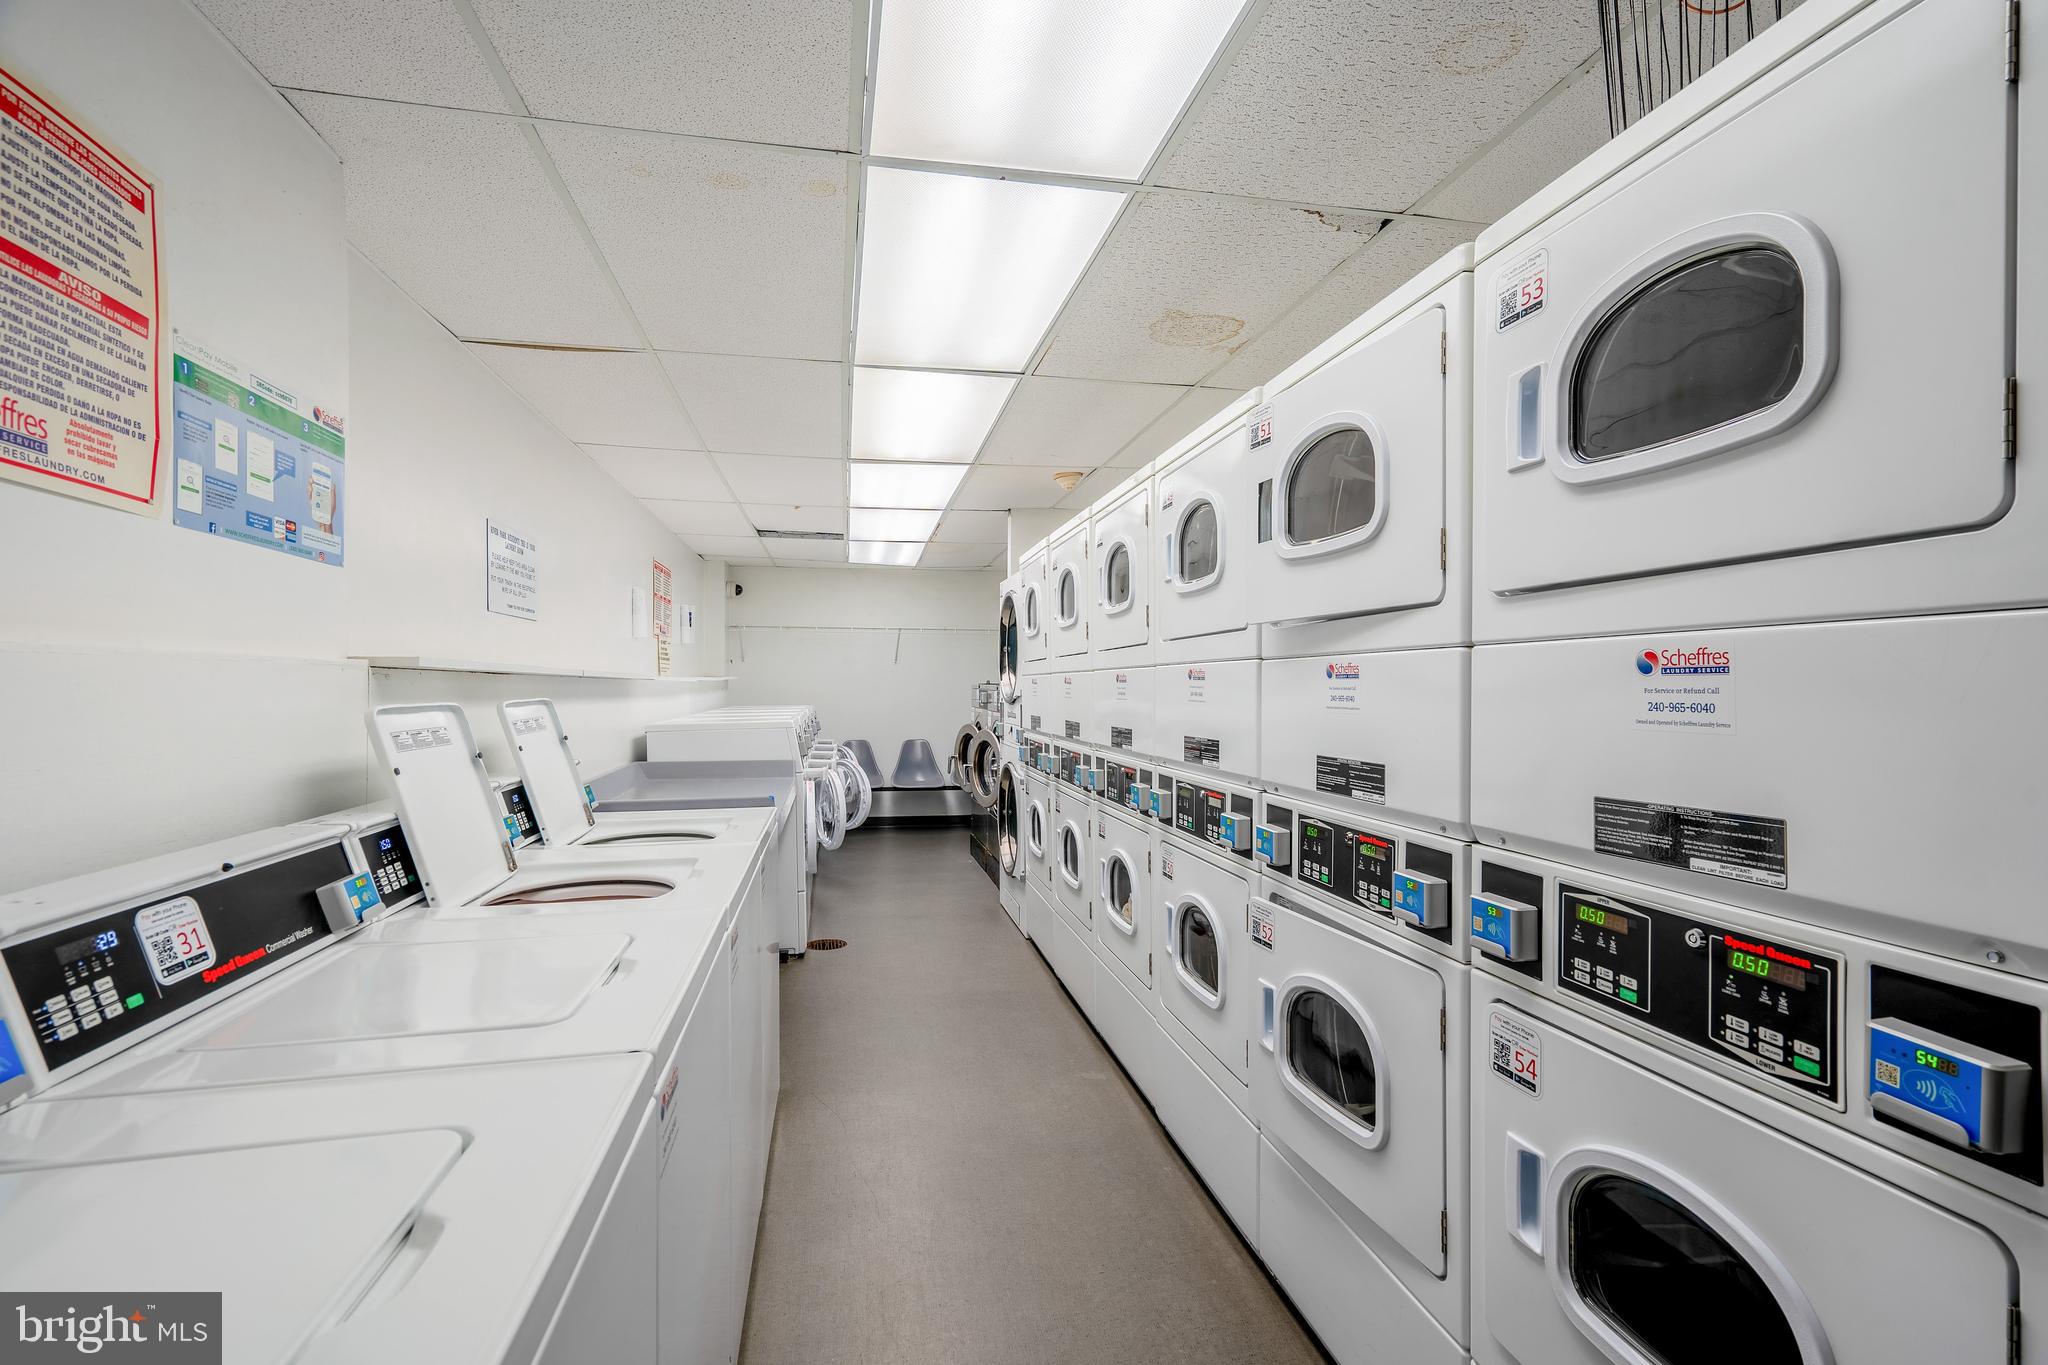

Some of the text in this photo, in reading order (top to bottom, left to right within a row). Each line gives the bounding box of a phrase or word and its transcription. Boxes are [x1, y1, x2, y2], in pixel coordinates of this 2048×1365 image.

[31, 153, 39, 165] LA
[42, 160, 85, 197] TEMPERATURA
[88, 193, 94, 203] DE
[1, 192, 15, 207] POR
[45, 219, 61, 235] DEJE
[63, 230, 74, 243] LAS
[8, 224, 16, 235] EL
[40, 242, 49, 254] DE
[51, 249, 59, 260] LA
[58, 271, 101, 303] AVISO
[1521, 277, 1543, 306] 53
[12, 274, 42, 296] MAYORIA
[45, 292, 54, 302] DE
[56, 298, 64, 307] LA
[66, 303, 82, 317] ROPA
[84, 312, 106, 329] ACTUAL
[108, 324, 121, 337] ESTA
[61, 312, 68, 322] DE
[71, 318, 101, 338] MATERIAL
[136, 351, 143, 359] SE
[3, 334, 135, 397] SECADA EN EXCESO EN UNA SECADORA DE
[8, 324, 147, 393] ROPA LAVADA EN AGUA DEMASIADO CALIENTE
[183, 362, 187, 374] 1
[30, 370, 64, 390] DE COLOR.
[249, 395, 254, 406] 2
[0, 395, 47, 439] ffres
[60, 404, 68, 413] DE
[70, 408, 77, 416] LA
[137, 433, 145, 442] DE
[303, 422, 308, 432] 3
[66, 428, 95, 444] prohibido
[96, 439, 110, 449] lavar
[69, 419, 113, 440] Absolutamente
[1260, 422, 1271, 438] 51
[3, 432, 46, 452] SERVICE
[64, 438, 80, 448] secar
[67, 447, 75, 456] en
[77, 451, 85, 459] las
[1661, 647, 1729, 666] Scheffres
[1647, 701, 1716, 713] 240-965-6040
[1720, 865, 1752, 874] IMPORTANT:
[1736, 873, 1753, 881] BEFORE
[1488, 907, 1496, 916] 53
[1580, 906, 1605, 925] 0.50
[177, 927, 206, 955] 31
[1262, 925, 1272, 942] 52
[202, 959, 237, 983] Speed
[234, 947, 267, 968] Queen
[266, 933, 296, 953] Commercial
[295, 926, 314, 940] Washer
[1724, 935, 1811, 969] Speed Queen
[1733, 952, 1769, 977] 0.50
[1514, 1050, 1537, 1081] 54
[1756, 1058, 1776, 1072] LOWER
[1916, 1050, 1937, 1068] 54
